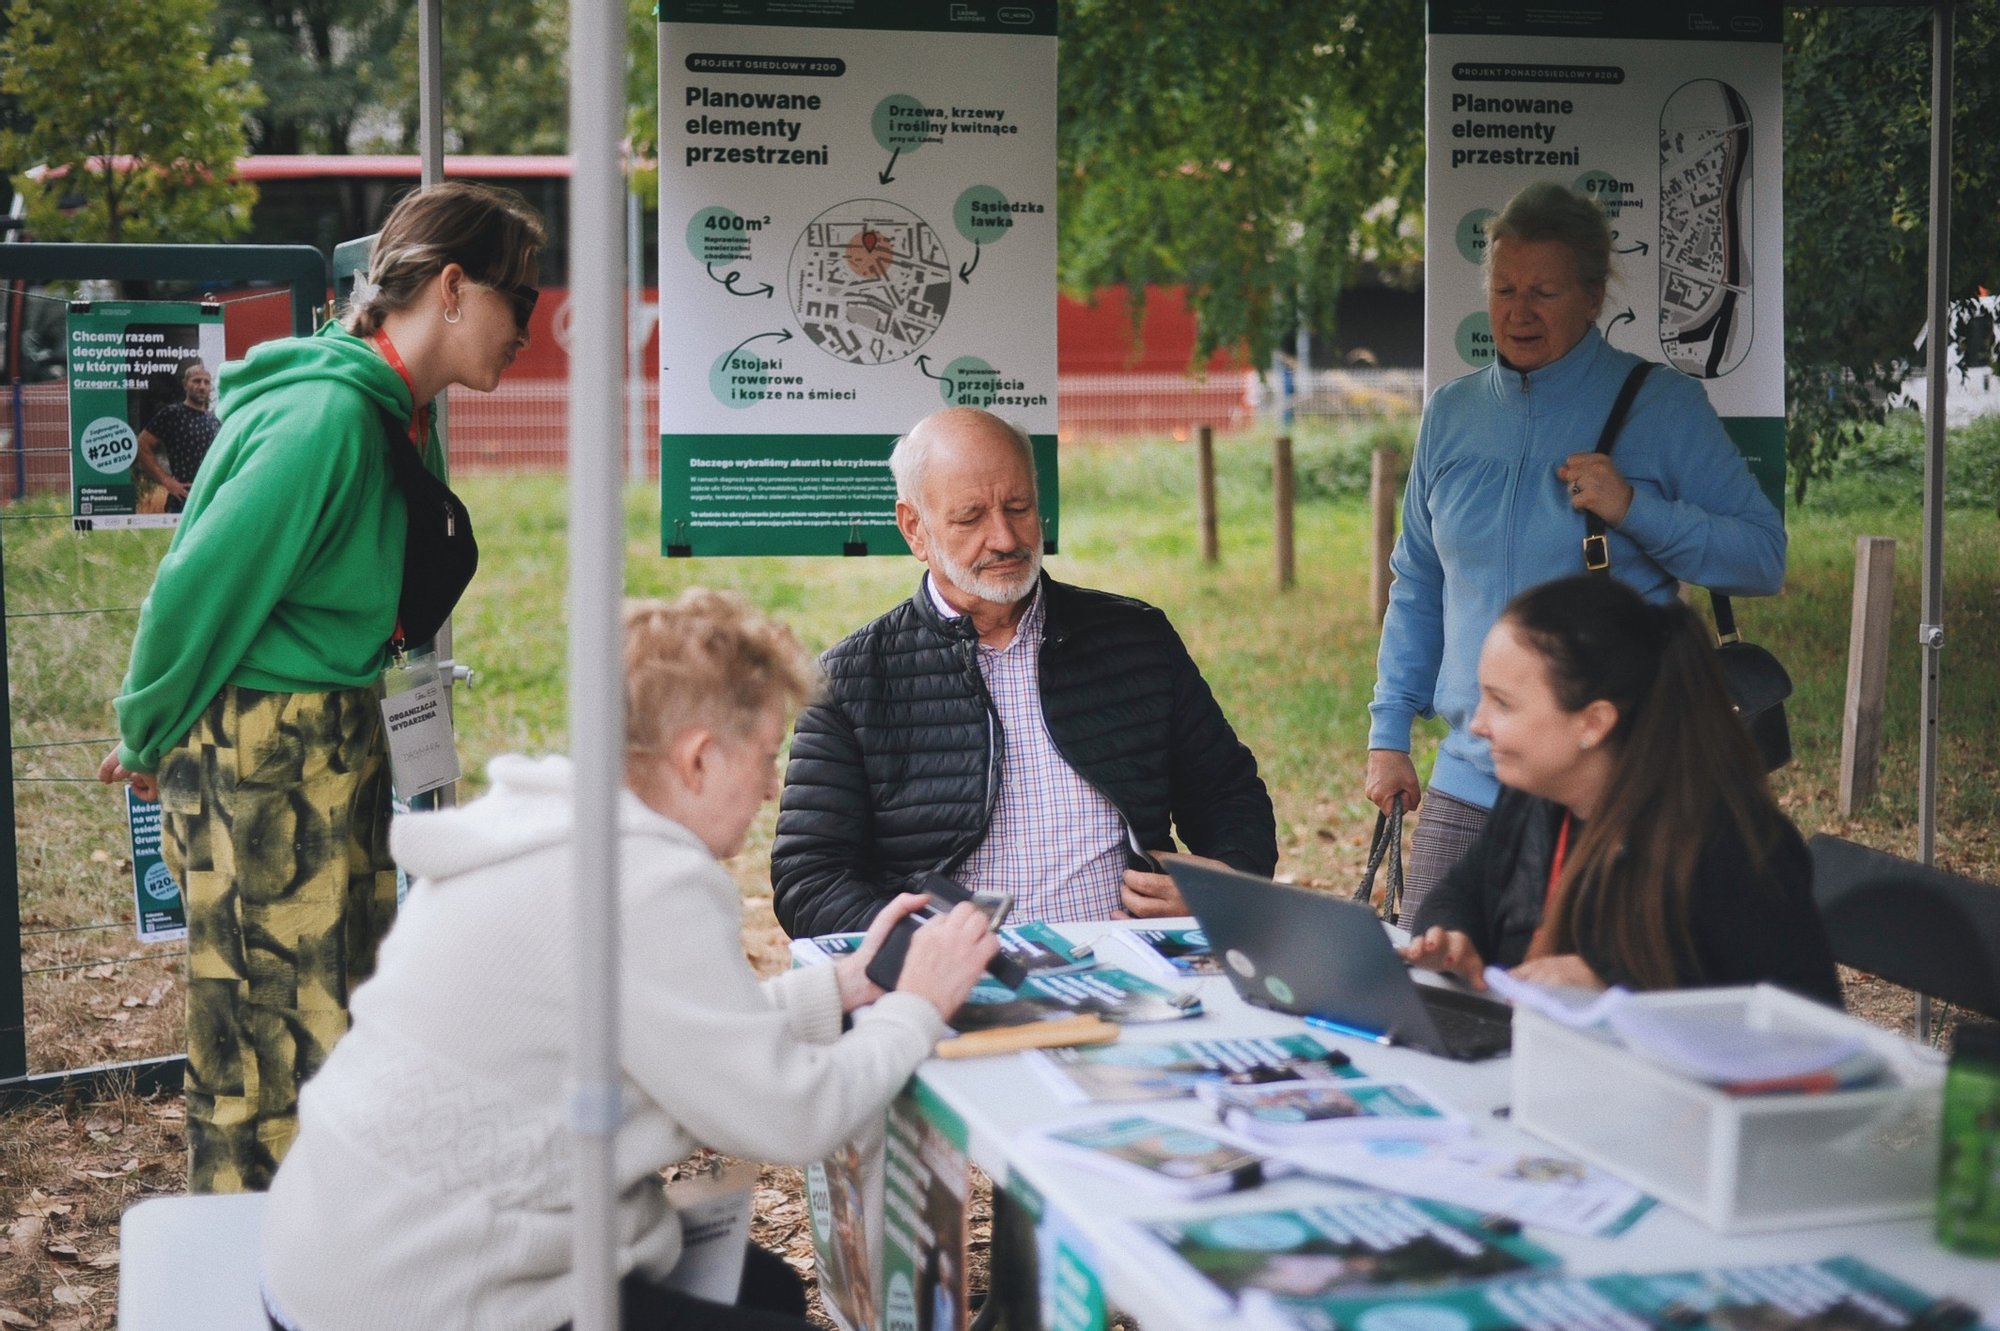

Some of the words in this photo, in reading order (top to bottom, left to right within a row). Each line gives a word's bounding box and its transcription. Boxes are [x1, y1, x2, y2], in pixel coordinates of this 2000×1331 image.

[694, 58, 742, 68] PROJEKT
[745, 60, 807, 70] OSIEDLOWY
[810, 62, 837, 72] #200
[1458, 68, 1502, 76] PROJEKT
[1504, 68, 1592, 78] PONADOSIEDLOWY
[686, 86, 821, 110] Planowane
[1452, 94, 1573, 114] Planowane
[889, 105, 948, 120] Drzewa,
[952, 107, 1005, 121] krzewy
[686, 115, 802, 142] elementy
[889, 120, 894, 132] i
[898, 120, 948, 134] rośliny
[952, 122, 1018, 136] kwitnące
[1452, 120, 1556, 144] elementy
[686, 144, 828, 166] przestrzeni
[1452, 146, 1580, 168] przestrzeni
[1586, 179, 1634, 193] 679m
[972, 200, 1044, 214] Sąsiedzka
[705, 215, 771, 231] 400m²
[971, 216, 1014, 227] ławka
[72, 331, 124, 344] Chcemy
[126, 333, 164, 343] razem
[72, 346, 144, 361] decydować
[146, 349, 154, 358] o
[1472, 348, 1488, 358] na
[74, 364, 84, 373] w
[86, 361, 132, 374] którym
[134, 361, 178, 374] żyjemy
[732, 358, 782, 372] Stojaki
[122, 379, 135, 388] 38
[136, 379, 149, 389] lat
[732, 376, 804, 385] rowerowe
[958, 378, 1024, 392] przejścia
[732, 389, 736, 400] i
[740, 389, 782, 400] kosze
[787, 391, 804, 400] na
[808, 388, 856, 400] śmieci
[958, 394, 980, 406] dla
[984, 394, 1048, 408] pieszych
[88, 437, 132, 460] #200
[690, 458, 734, 470] Dlaczego
[735, 458, 790, 469] wybraliśmy
[790, 458, 820, 467] akurat
[822, 458, 832, 467] to
[388, 700, 438, 722] ORGANIZACJA
[390, 710, 437, 732] WYDARZENIA
[132, 816, 144, 824] na
[150, 876, 174, 892] #20
